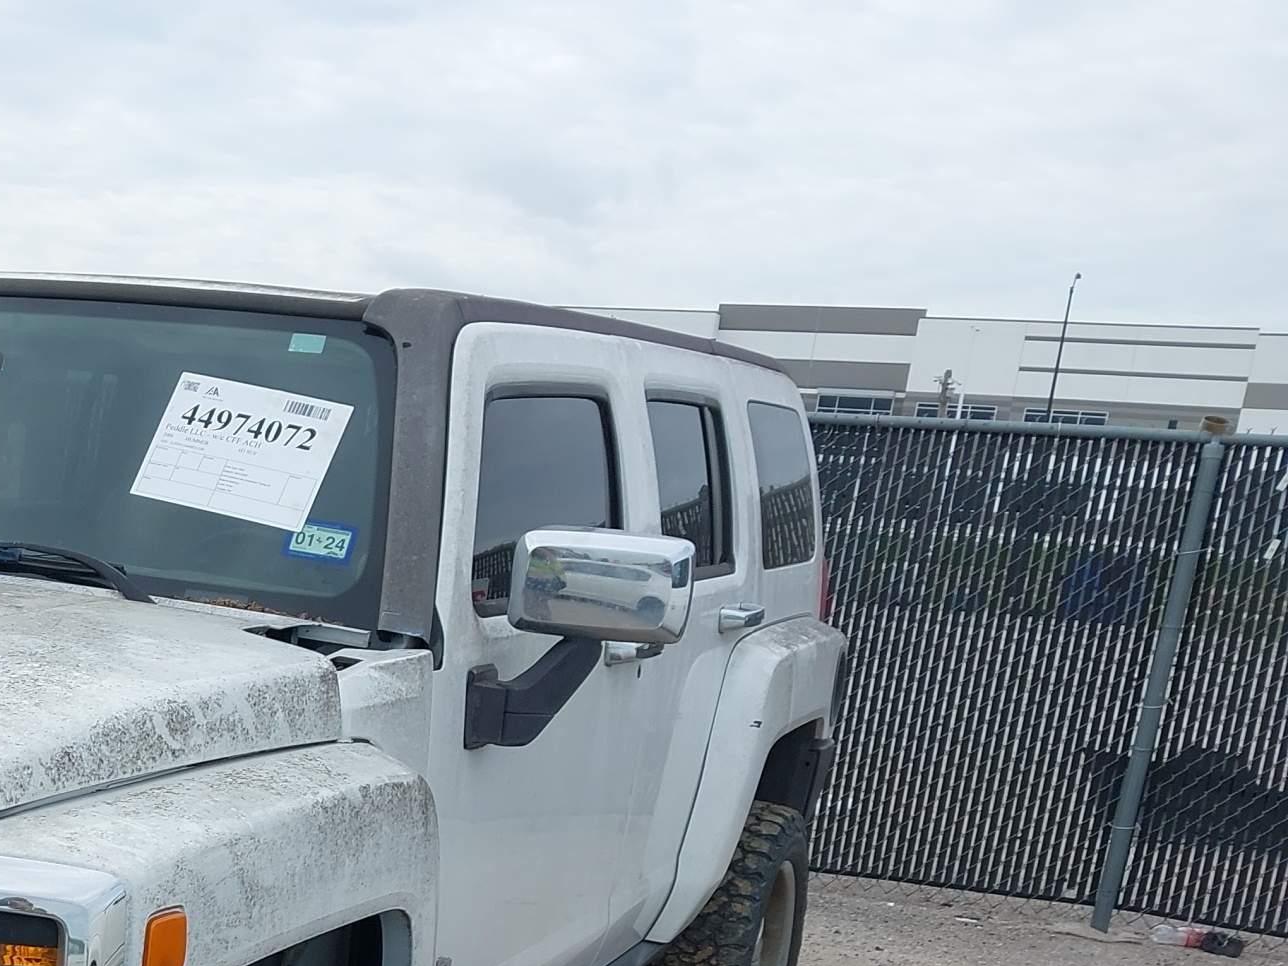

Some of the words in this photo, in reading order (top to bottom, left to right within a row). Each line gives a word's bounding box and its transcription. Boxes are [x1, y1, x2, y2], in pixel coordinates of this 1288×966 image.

[181, 404, 318, 451] 44974072
[295, 531, 315, 547] 01
[323, 536, 347, 552] 24
